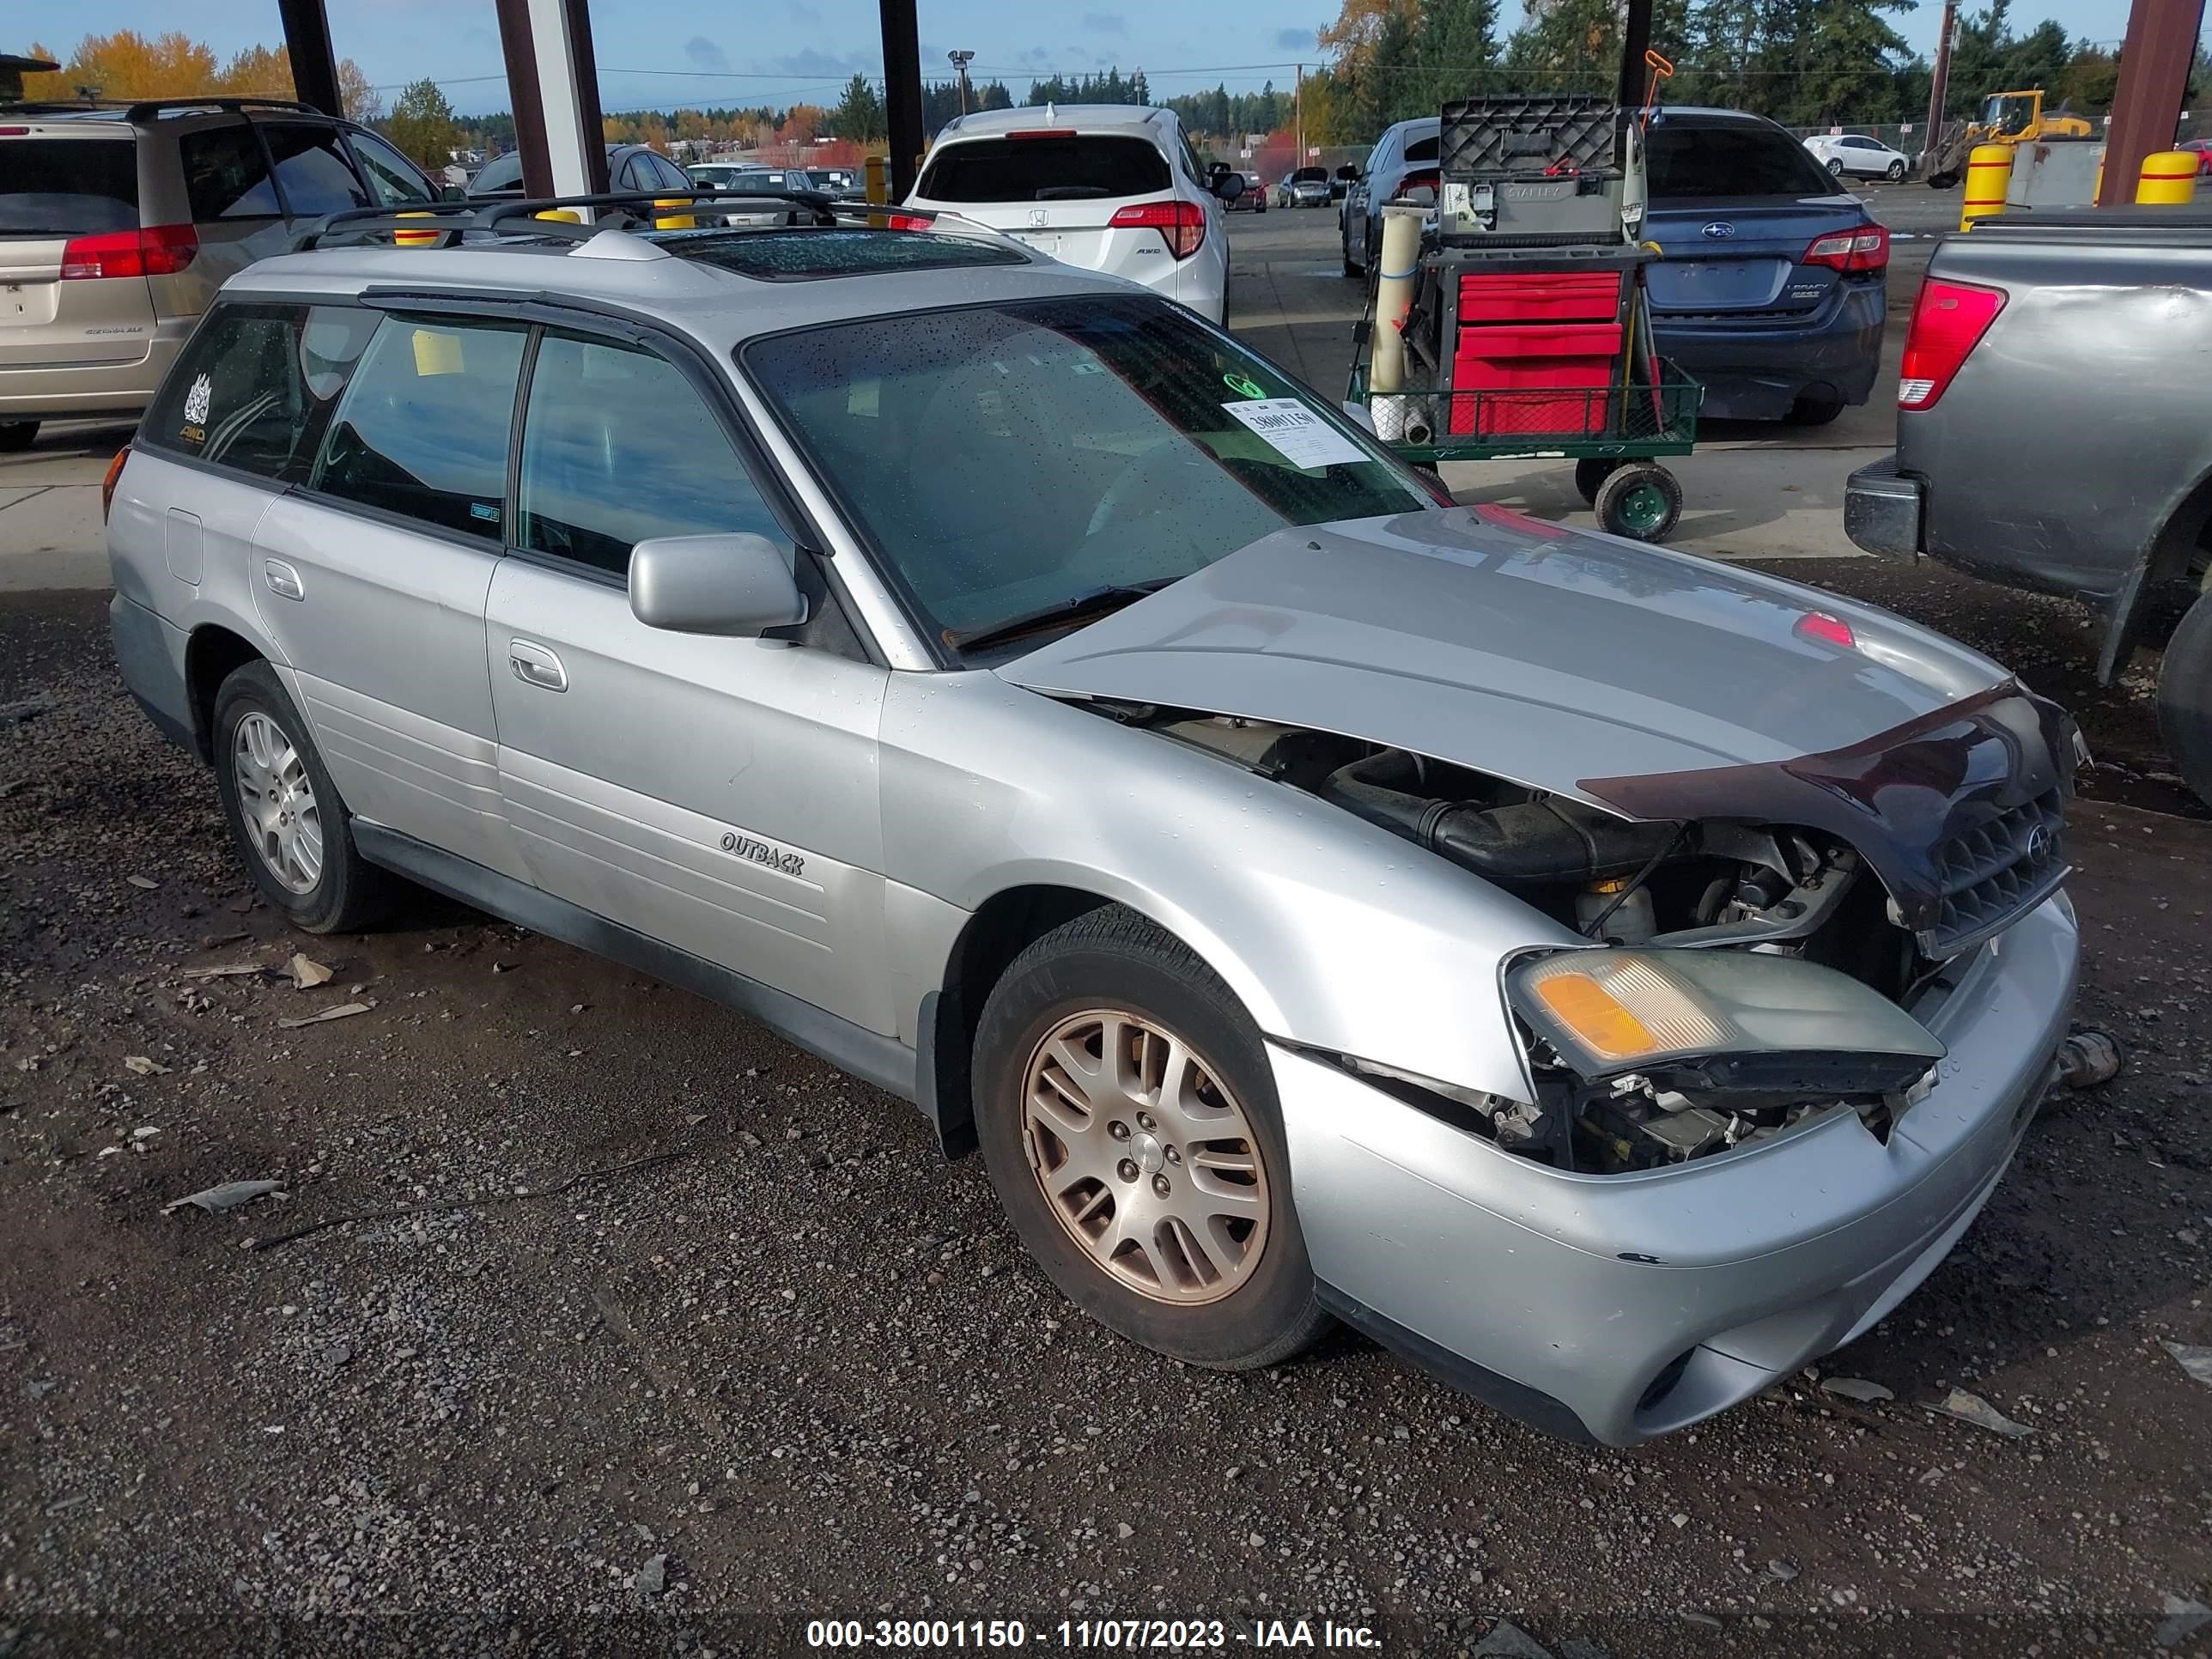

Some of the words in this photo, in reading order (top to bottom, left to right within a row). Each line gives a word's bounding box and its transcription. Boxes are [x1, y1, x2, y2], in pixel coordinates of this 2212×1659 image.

[1509, 186, 1560, 198] STANLEY
[1249, 412, 1317, 429] 38001150
[179, 425, 205, 441] AWD
[720, 831, 805, 877] OUTBACK
